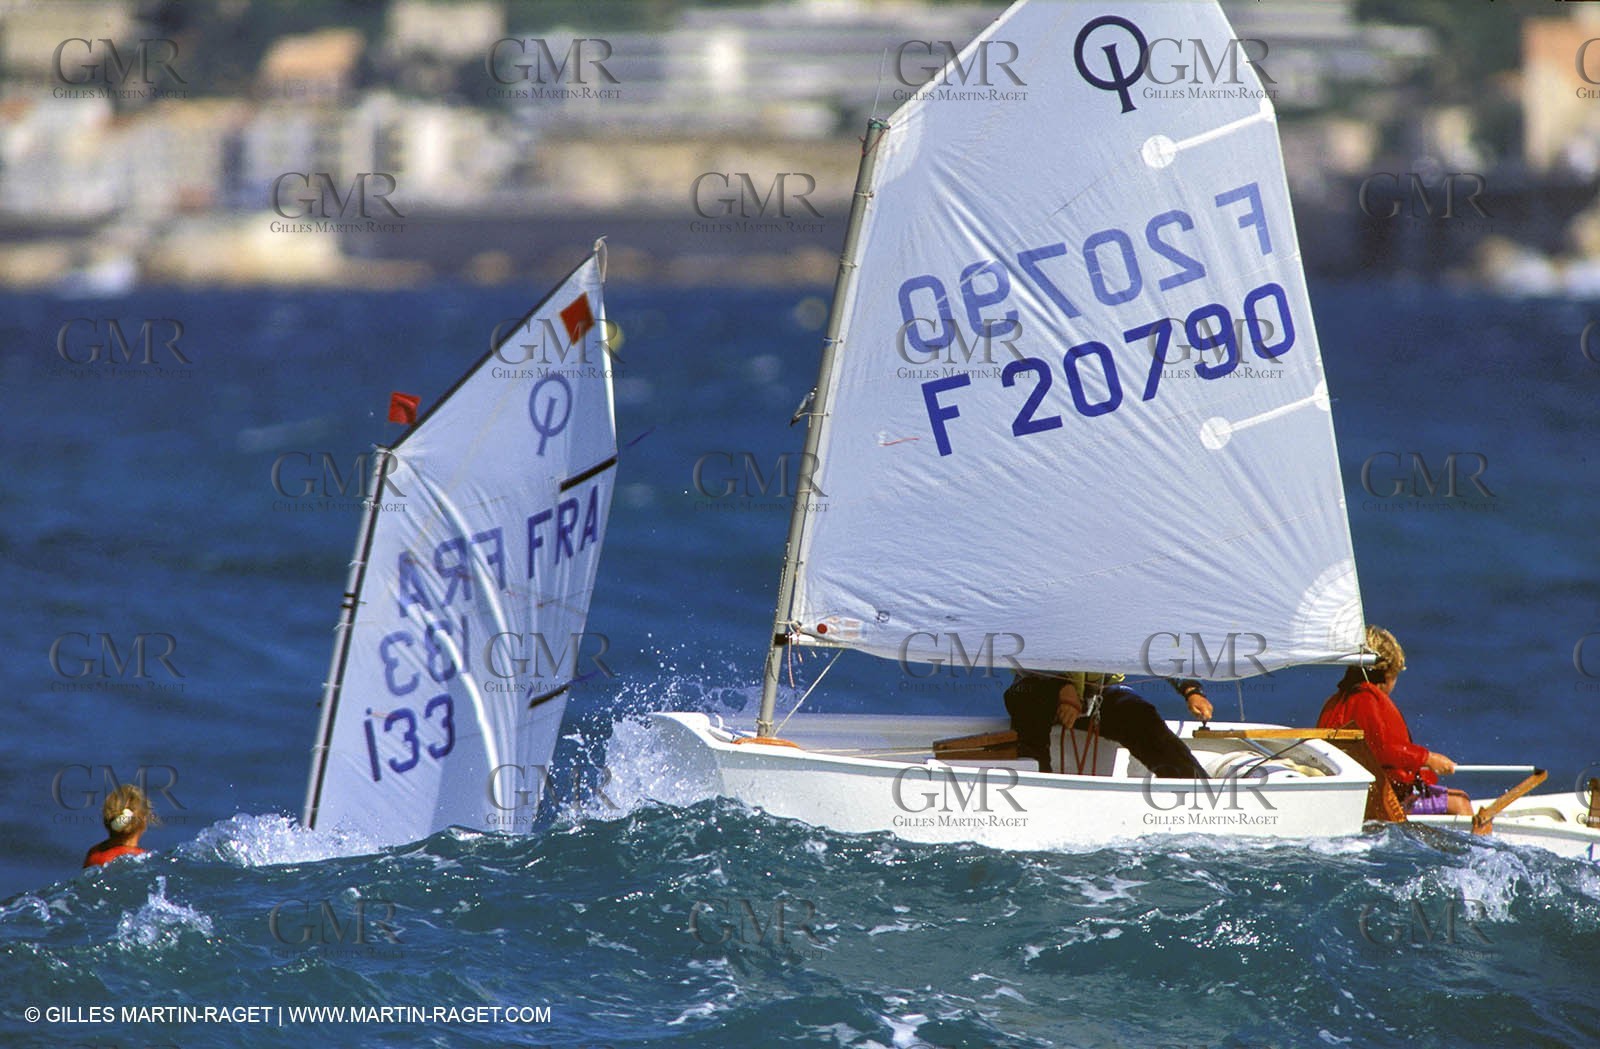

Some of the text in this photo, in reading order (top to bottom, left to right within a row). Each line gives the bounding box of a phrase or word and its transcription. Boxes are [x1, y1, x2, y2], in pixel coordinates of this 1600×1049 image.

[920, 282, 1296, 457] F 20790
[527, 485, 599, 580] FRA
